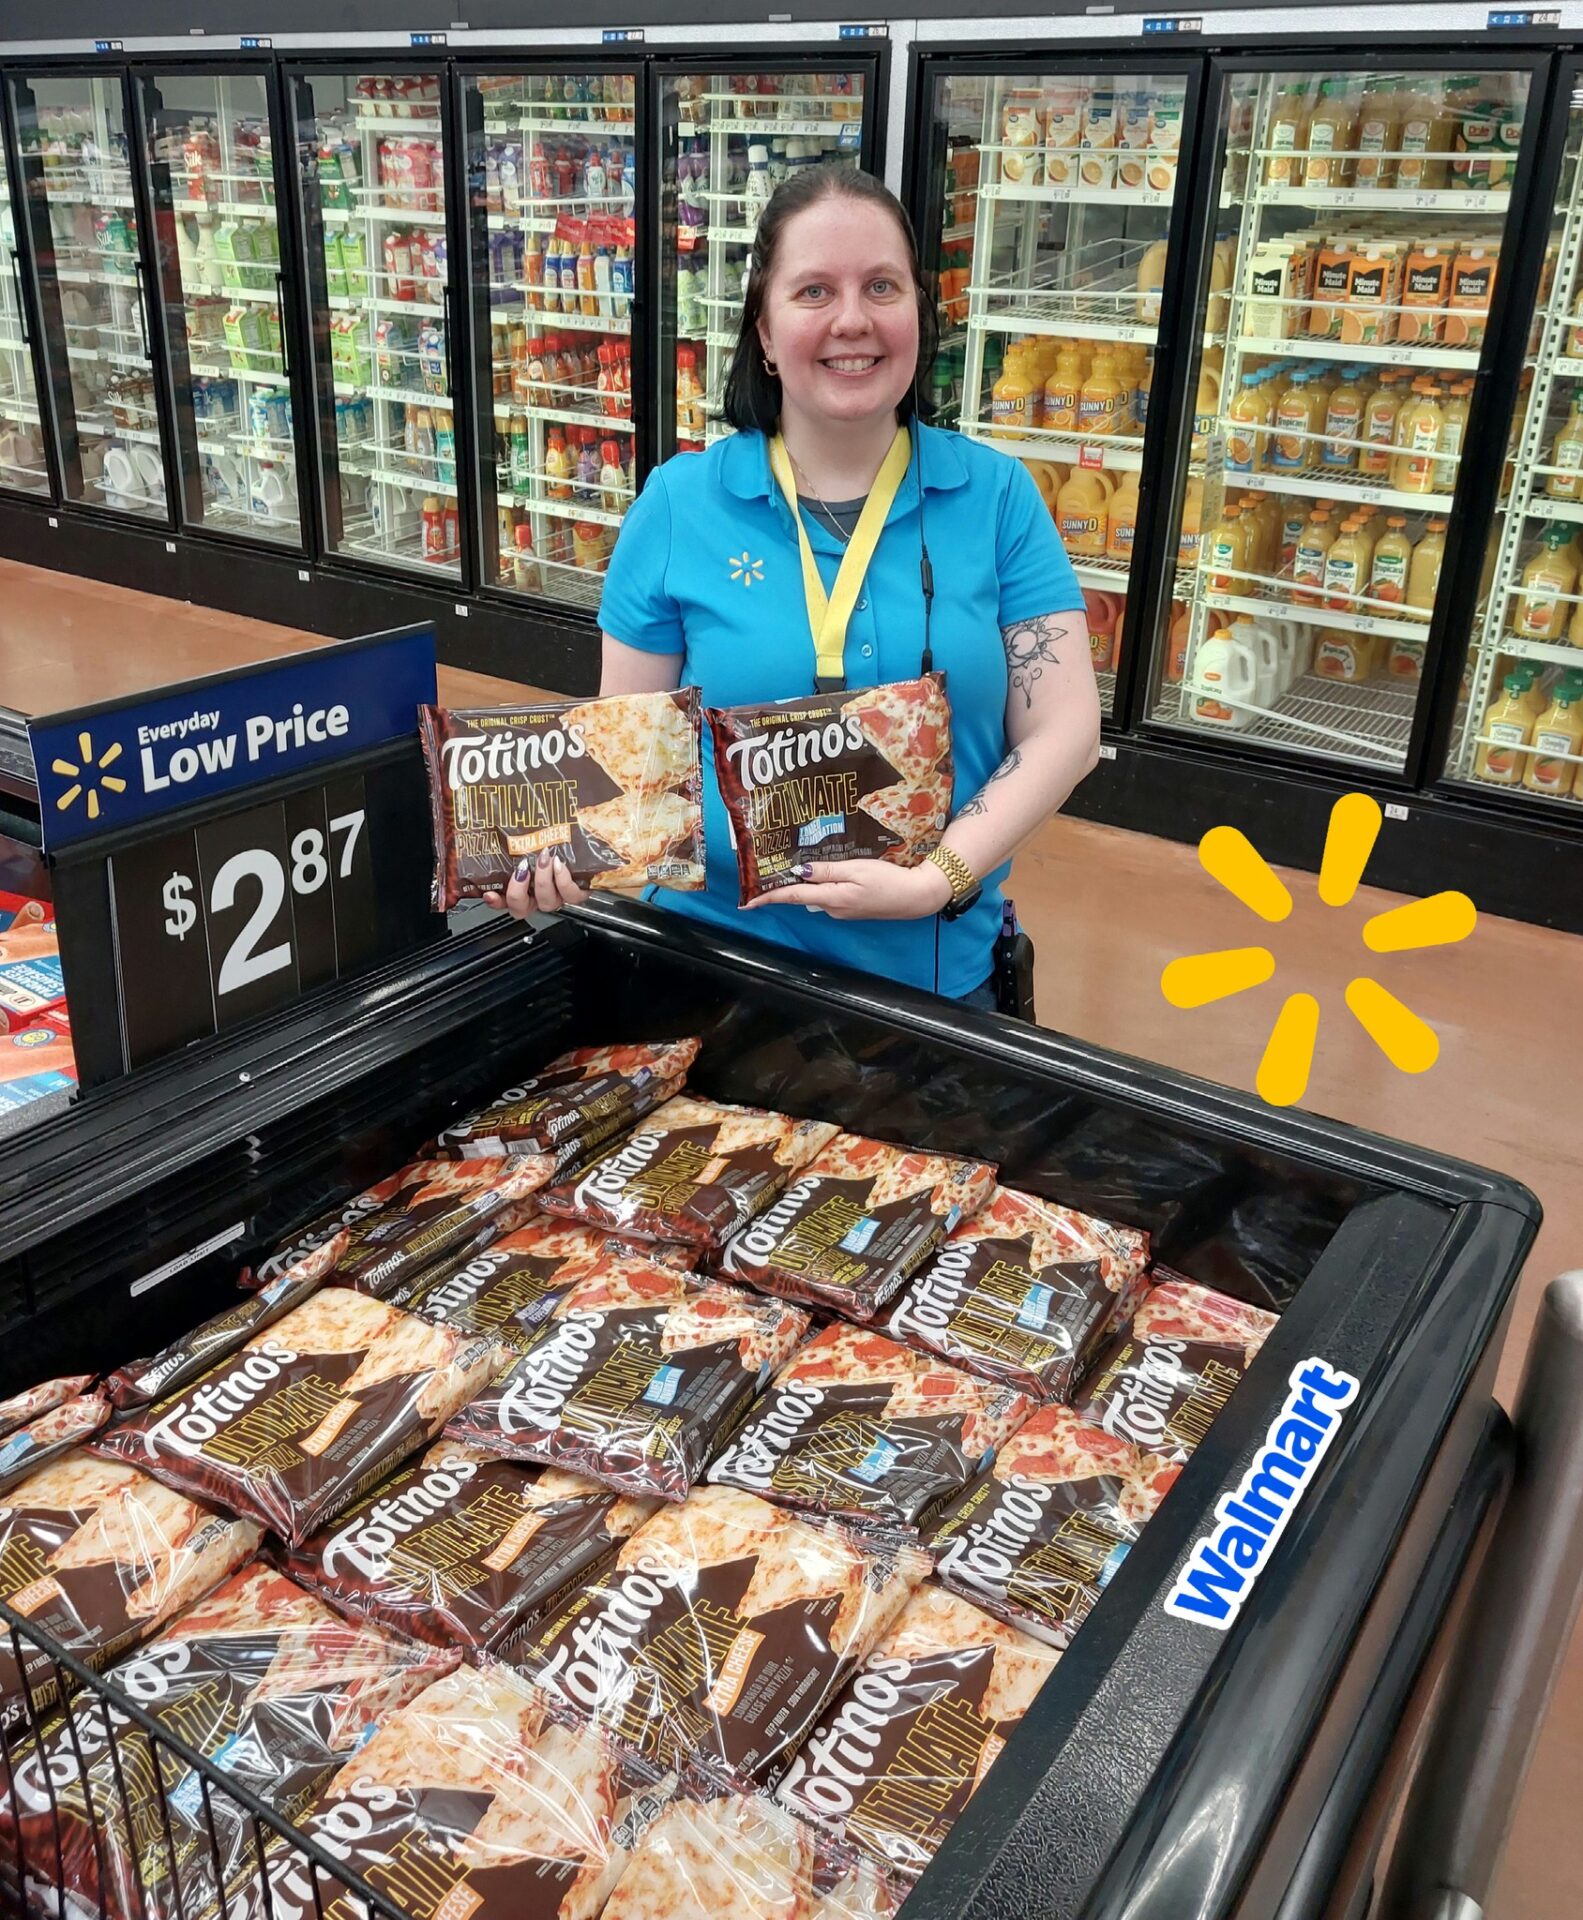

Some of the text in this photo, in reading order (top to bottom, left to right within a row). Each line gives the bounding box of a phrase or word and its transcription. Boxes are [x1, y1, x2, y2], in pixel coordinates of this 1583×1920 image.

[1254, 277, 1279, 288] Minute
[1257, 285, 1275, 293] Maid
[1322, 270, 1347, 280] Minute
[1324, 278, 1343, 287] Maid
[1354, 278, 1380, 288] Minute
[1357, 285, 1376, 294] Maid
[1412, 275, 1437, 285] Minute
[1415, 282, 1432, 291] Maid
[1459, 278, 1486, 287] Minute
[1461, 285, 1481, 294] Maid
[1062, 518, 1097, 532] SUNNYD
[138, 711, 220, 745] Everyday
[510, 716, 528, 725] CRISP
[750, 718, 761, 728] THE
[761, 713, 789, 727] ORIGINAL
[139, 703, 350, 793] Low Price
[441, 724, 586, 790] Totino's
[725, 713, 864, 792] Totino's
[453, 780, 579, 830] ULTIMATE
[751, 772, 860, 832] ULTIMATE
[456, 832, 500, 858] PIZZA
[509, 825, 571, 850] EXTRA CHEESE
[752, 829, 792, 857] PIZZA
[575, 1129, 669, 1209] Totino's
[723, 1177, 822, 1272] Totino's
[364, 1251, 406, 1290] Totino's
[889, 1240, 979, 1343] Totino's
[499, 1309, 606, 1434] Totino's
[144, 1340, 298, 1460] Totino's
[1103, 1334, 1187, 1444] Totino's
[201, 1375, 352, 1468] ULTIMATE
[707, 1377, 825, 1488] Totino's
[323, 1456, 479, 1582] Totino's
[508, 1513, 543, 1546] CHEESE
[938, 1473, 1058, 1600] Totino's
[14, 1578, 58, 1611] CHEESE
[570, 1590, 593, 1617] CRISP
[536, 1556, 692, 1724] Totino's
[33, 1653, 52, 1668] FROZE
[709, 1630, 764, 1715] EXTRA CHEESE
[731, 1680, 763, 1721] COMPARED
[743, 1697, 768, 1725] CHEESE
[776, 1652, 911, 1839] Totino's
